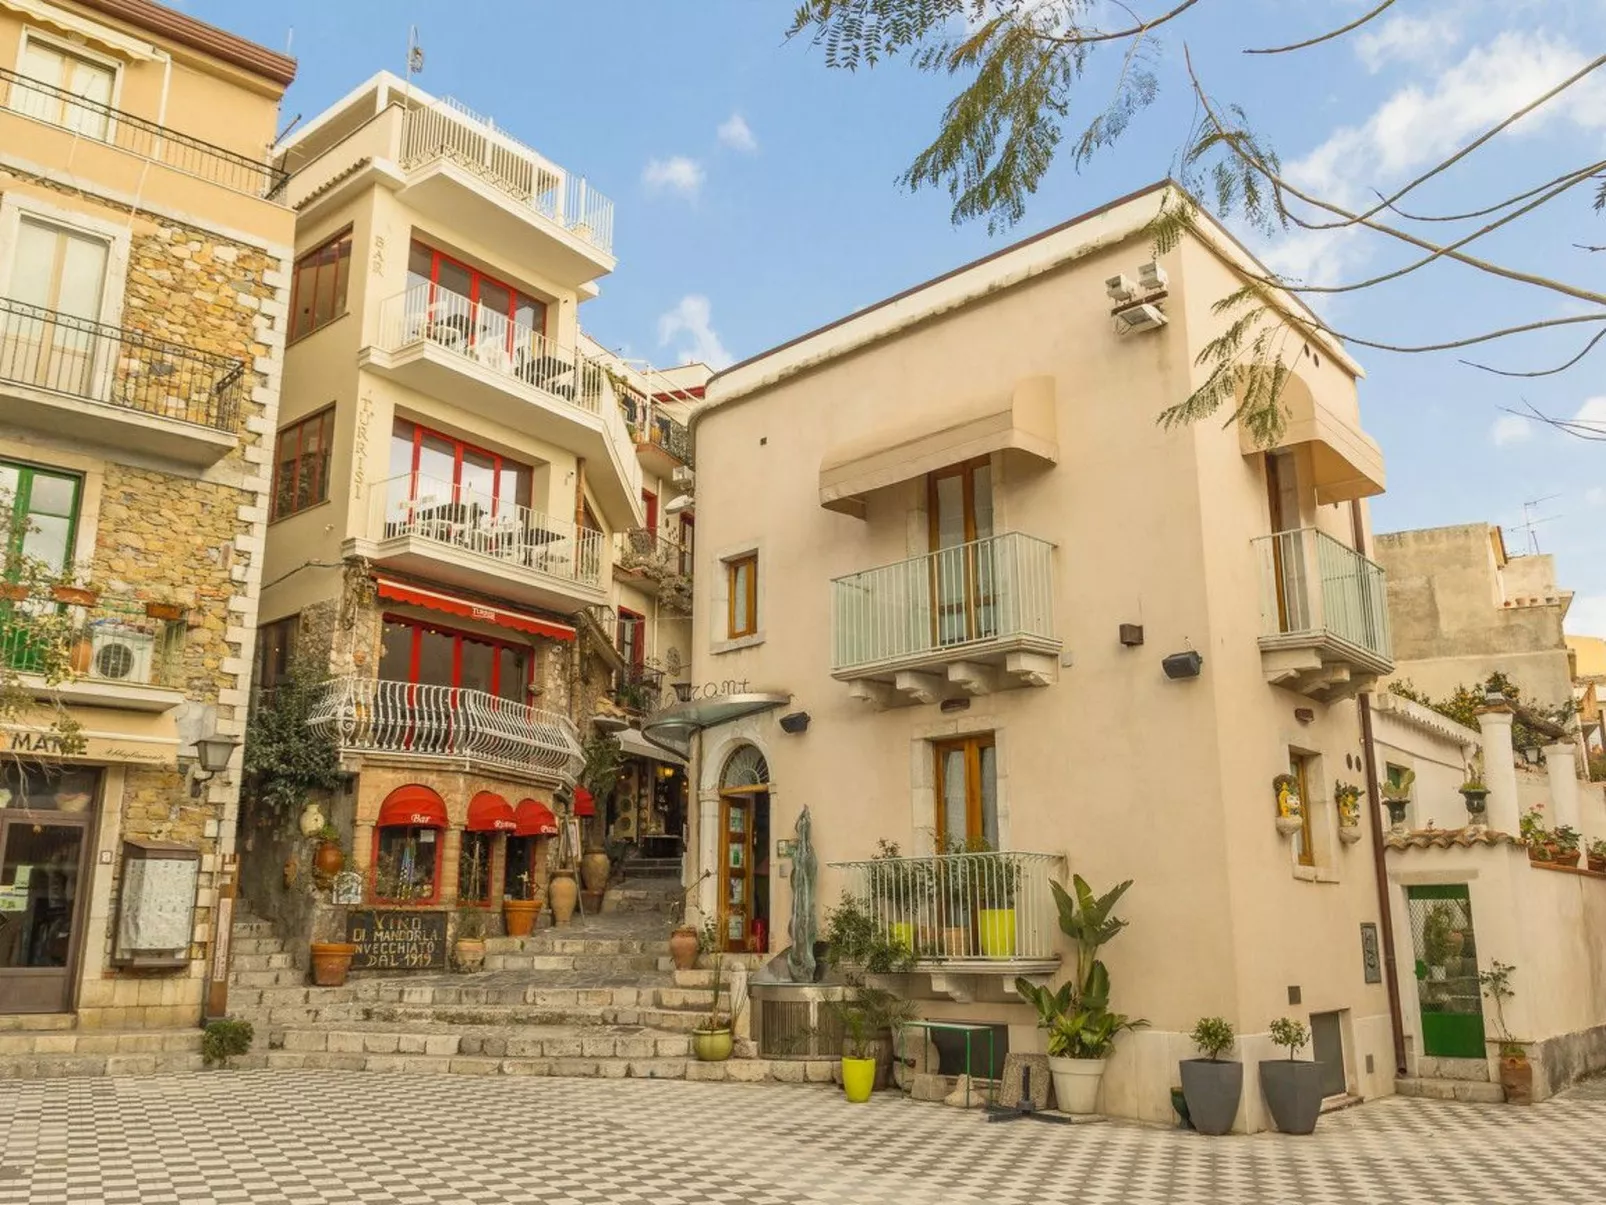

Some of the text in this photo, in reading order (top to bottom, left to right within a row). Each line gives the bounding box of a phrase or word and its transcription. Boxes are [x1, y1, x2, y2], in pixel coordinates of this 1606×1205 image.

[373, 235, 385, 278] BAR
[354, 397, 373, 500] TURRISI
[410, 813, 432, 824] Bar
[372, 911, 422, 930] VINO
[354, 941, 435, 955] NVECCHIATO
[365, 953, 432, 967] DAL 1919
